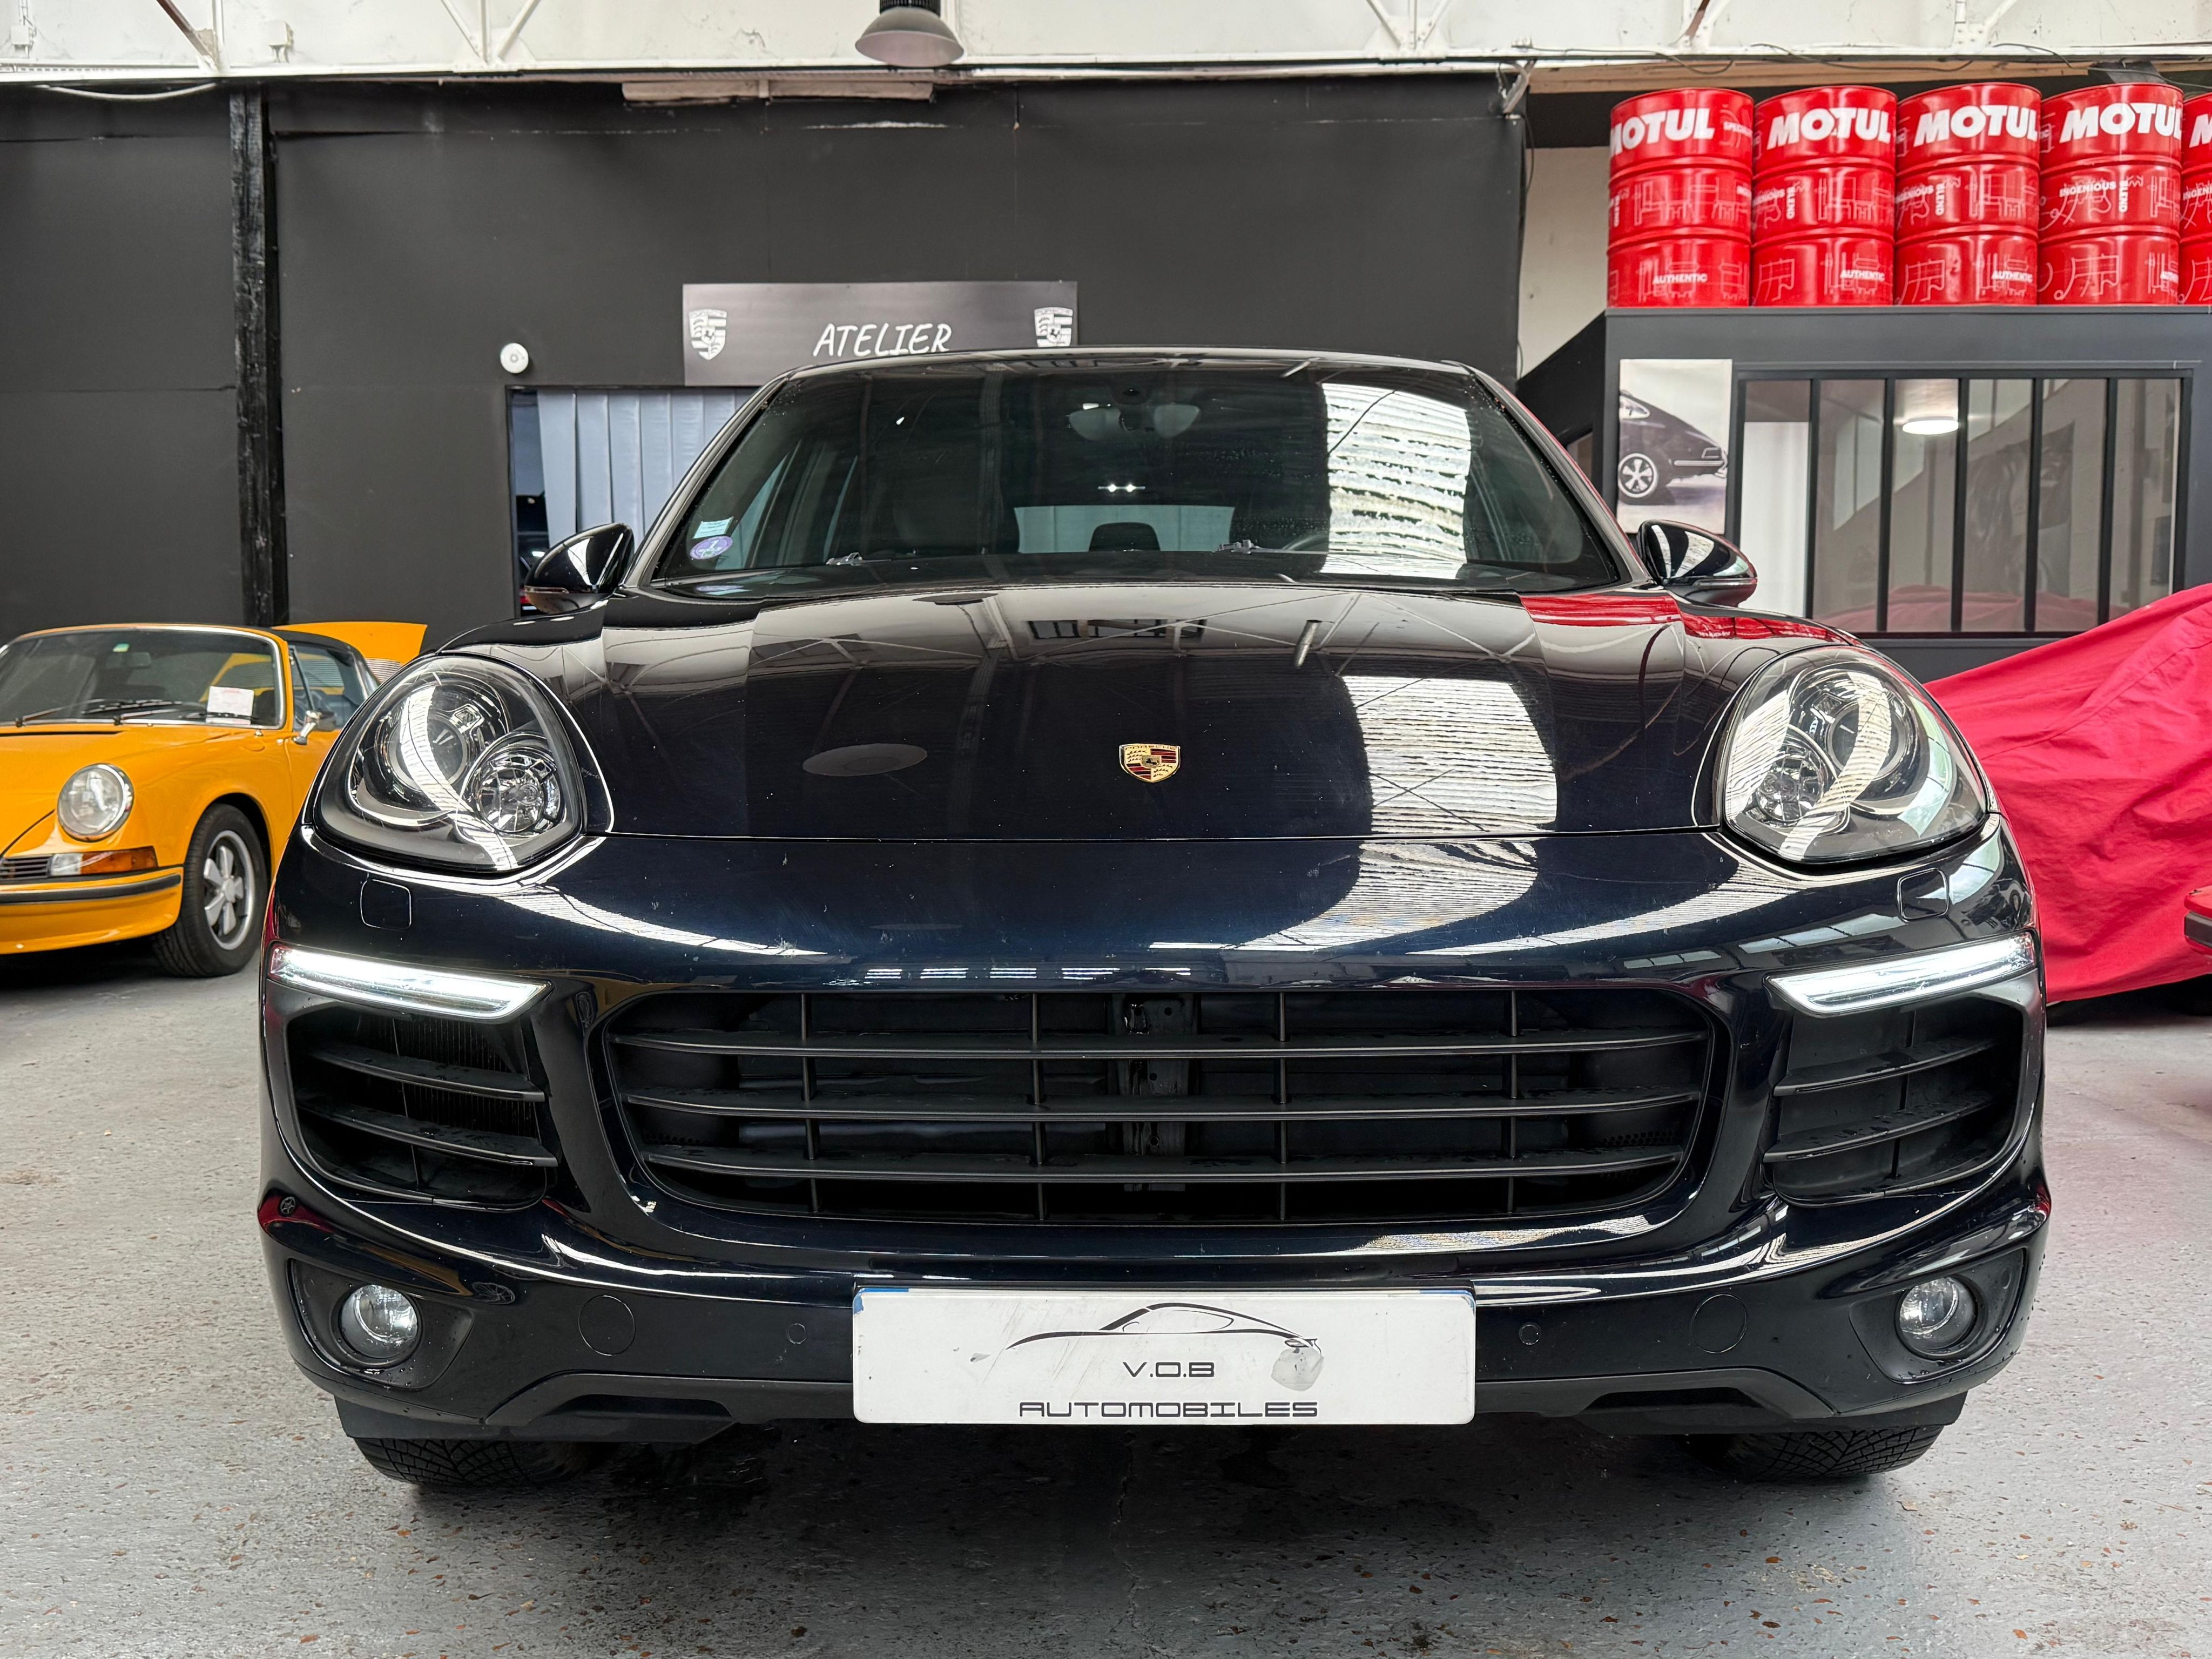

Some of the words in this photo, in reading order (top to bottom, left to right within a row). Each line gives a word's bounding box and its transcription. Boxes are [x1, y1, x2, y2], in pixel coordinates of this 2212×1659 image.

[1766, 107, 1891, 150] MOTUL
[1913, 105, 2038, 147] MOTUL
[2059, 103, 2182, 144] MOTUL
[2059, 181, 2116, 198] INGENIOUS
[1653, 273, 1708, 285] AUTHENTIC
[1840, 269, 1885, 282] AUTHENTIC
[813, 322, 952, 357] ATELIER
[1019, 1401, 1318, 1418] AUTOMOBILES
